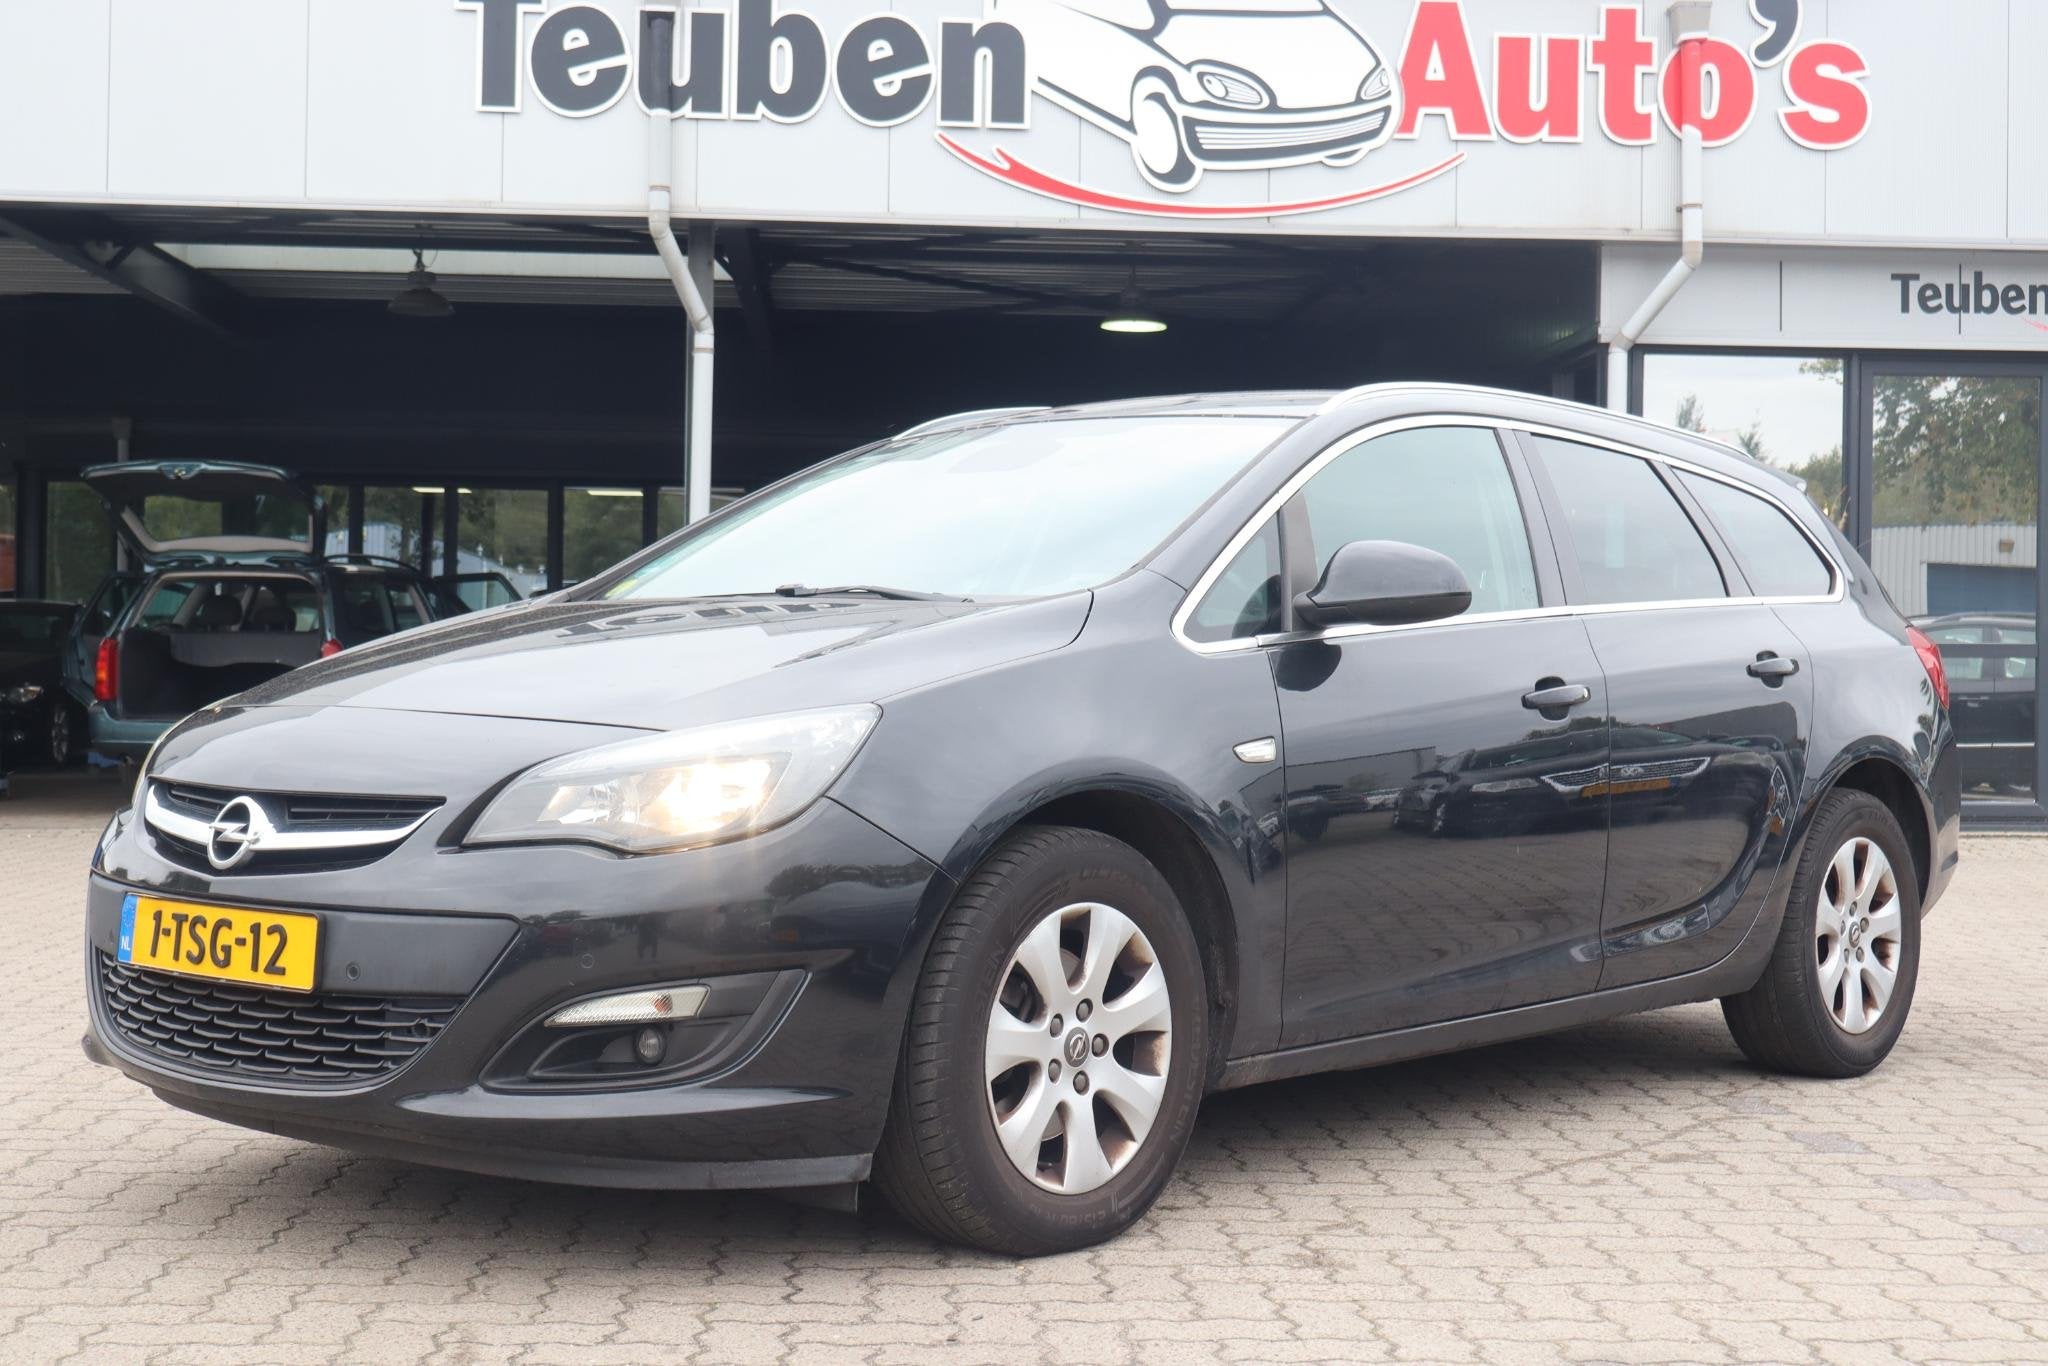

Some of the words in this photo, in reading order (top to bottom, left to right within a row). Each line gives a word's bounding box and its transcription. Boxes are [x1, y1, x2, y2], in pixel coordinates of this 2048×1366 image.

[458, 0, 1027, 124] Teuben
[1396, 0, 1870, 149] Auto's
[1891, 271, 2048, 314] Teuben
[121, 935, 130, 951] NL
[151, 909, 288, 976] 1-TSG-12
